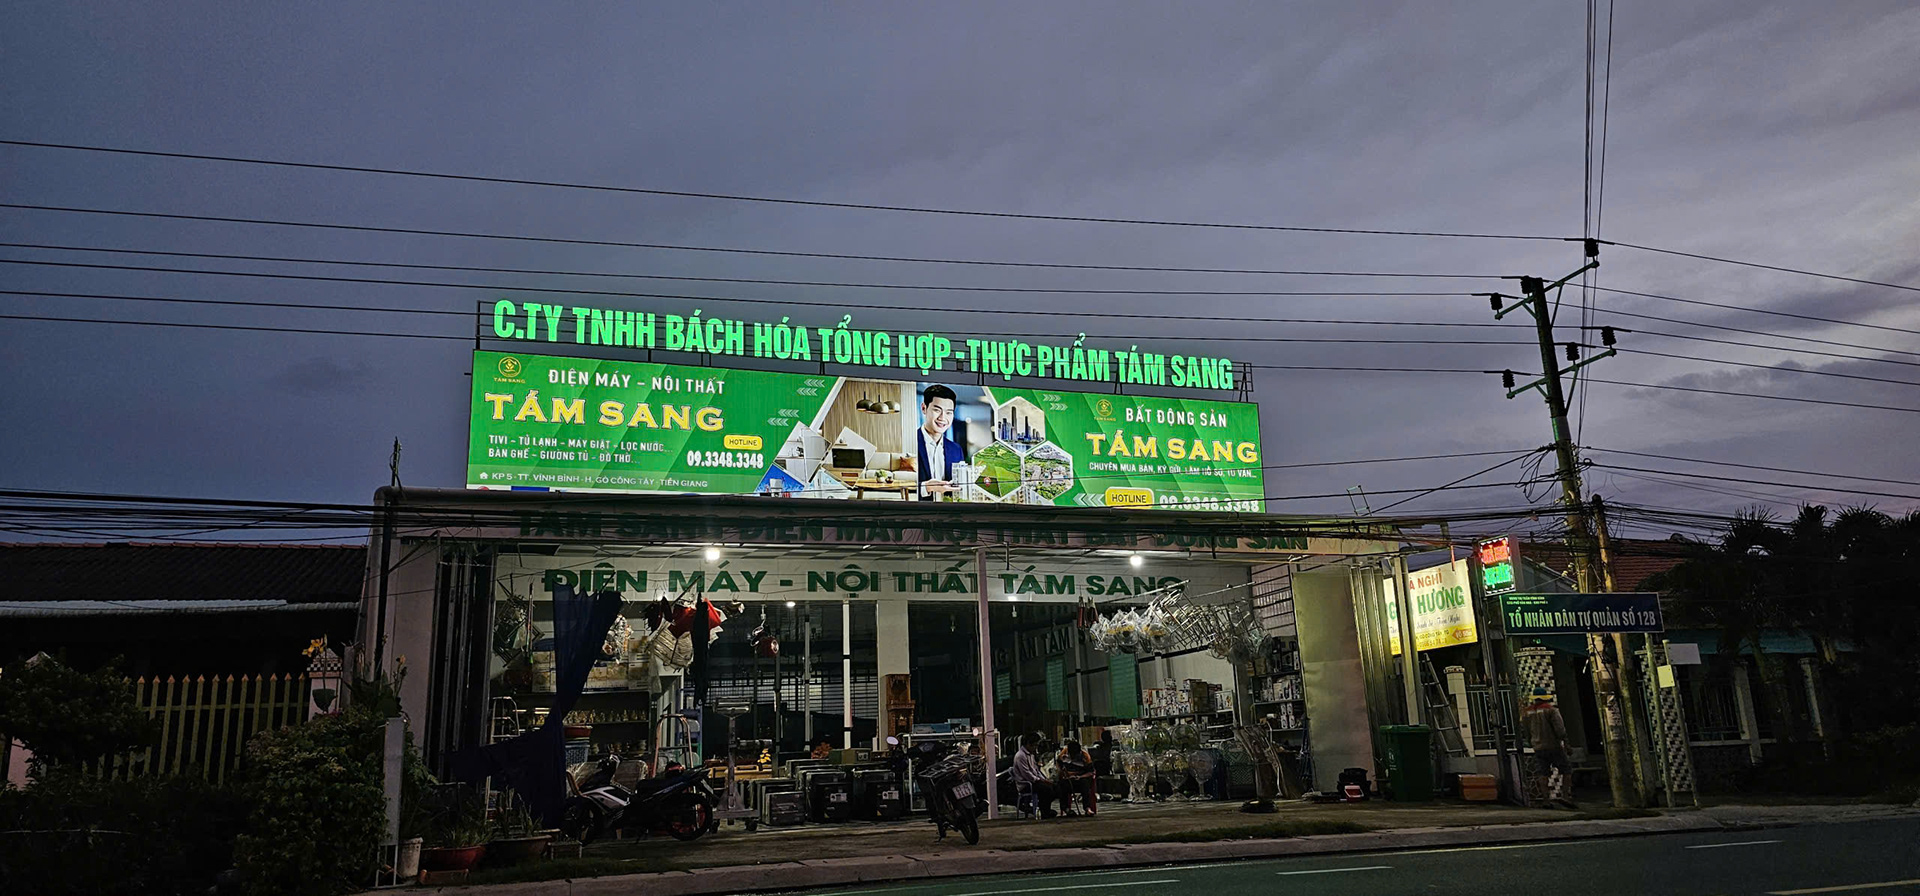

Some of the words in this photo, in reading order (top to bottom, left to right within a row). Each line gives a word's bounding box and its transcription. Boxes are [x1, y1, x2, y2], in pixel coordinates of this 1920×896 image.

[493, 299, 563, 342] C.TY
[572, 306, 656, 349] TNHH
[666, 309, 744, 356] BÁCH
[754, 316, 811, 361] HÓA
[817, 314, 891, 367] TỔNG
[898, 333, 951, 376] HỢP
[1037, 332, 1110, 382] PHẨM
[1115, 345, 1166, 386] TÁM
[1170, 354, 1234, 390] SANG
[548, 367, 589, 387] ĐIỆN
[595, 371, 631, 389] MÁY
[651, 375, 680, 394] NỘI
[685, 376, 725, 395] THẤT
[484, 389, 587, 425] TÁM
[597, 400, 725, 432] SANG
[1125, 403, 1152, 423] BẤT
[1157, 408, 1195, 427] ĐỘNG
[1200, 408, 1227, 428] SẢN
[489, 434, 508, 445] TIVI
[533, 437, 557, 448] LẠNH
[728, 438, 758, 447] HOTLINE
[1085, 429, 1159, 459] TÁM
[1167, 437, 1258, 464] SANG
[488, 446, 508, 458] BÀN
[687, 450, 764, 469] 09.3348.3348
[1089, 461, 1118, 471] CHUYÊN
[1120, 464, 1136, 473] MUA
[680, 480, 708, 488] GIANG
[1111, 494, 1147, 504] HOTLINE
[1159, 494, 1260, 512] 09.3348.3348
[668, 560, 767, 593] MÁY
[807, 563, 880, 599] NỘI
[998, 564, 1076, 596] TÁM
[1416, 585, 1465, 615] HƯƠNG
[1508, 606, 1522, 628] TỔ
[1524, 609, 1553, 628] NHÂN
[1554, 608, 1577, 627] DÂN
[1577, 610, 1591, 629] TỰ
[1592, 606, 1621, 628] QUẢN
[1622, 606, 1636, 626] SỐ
[1637, 610, 1656, 626] 12B
